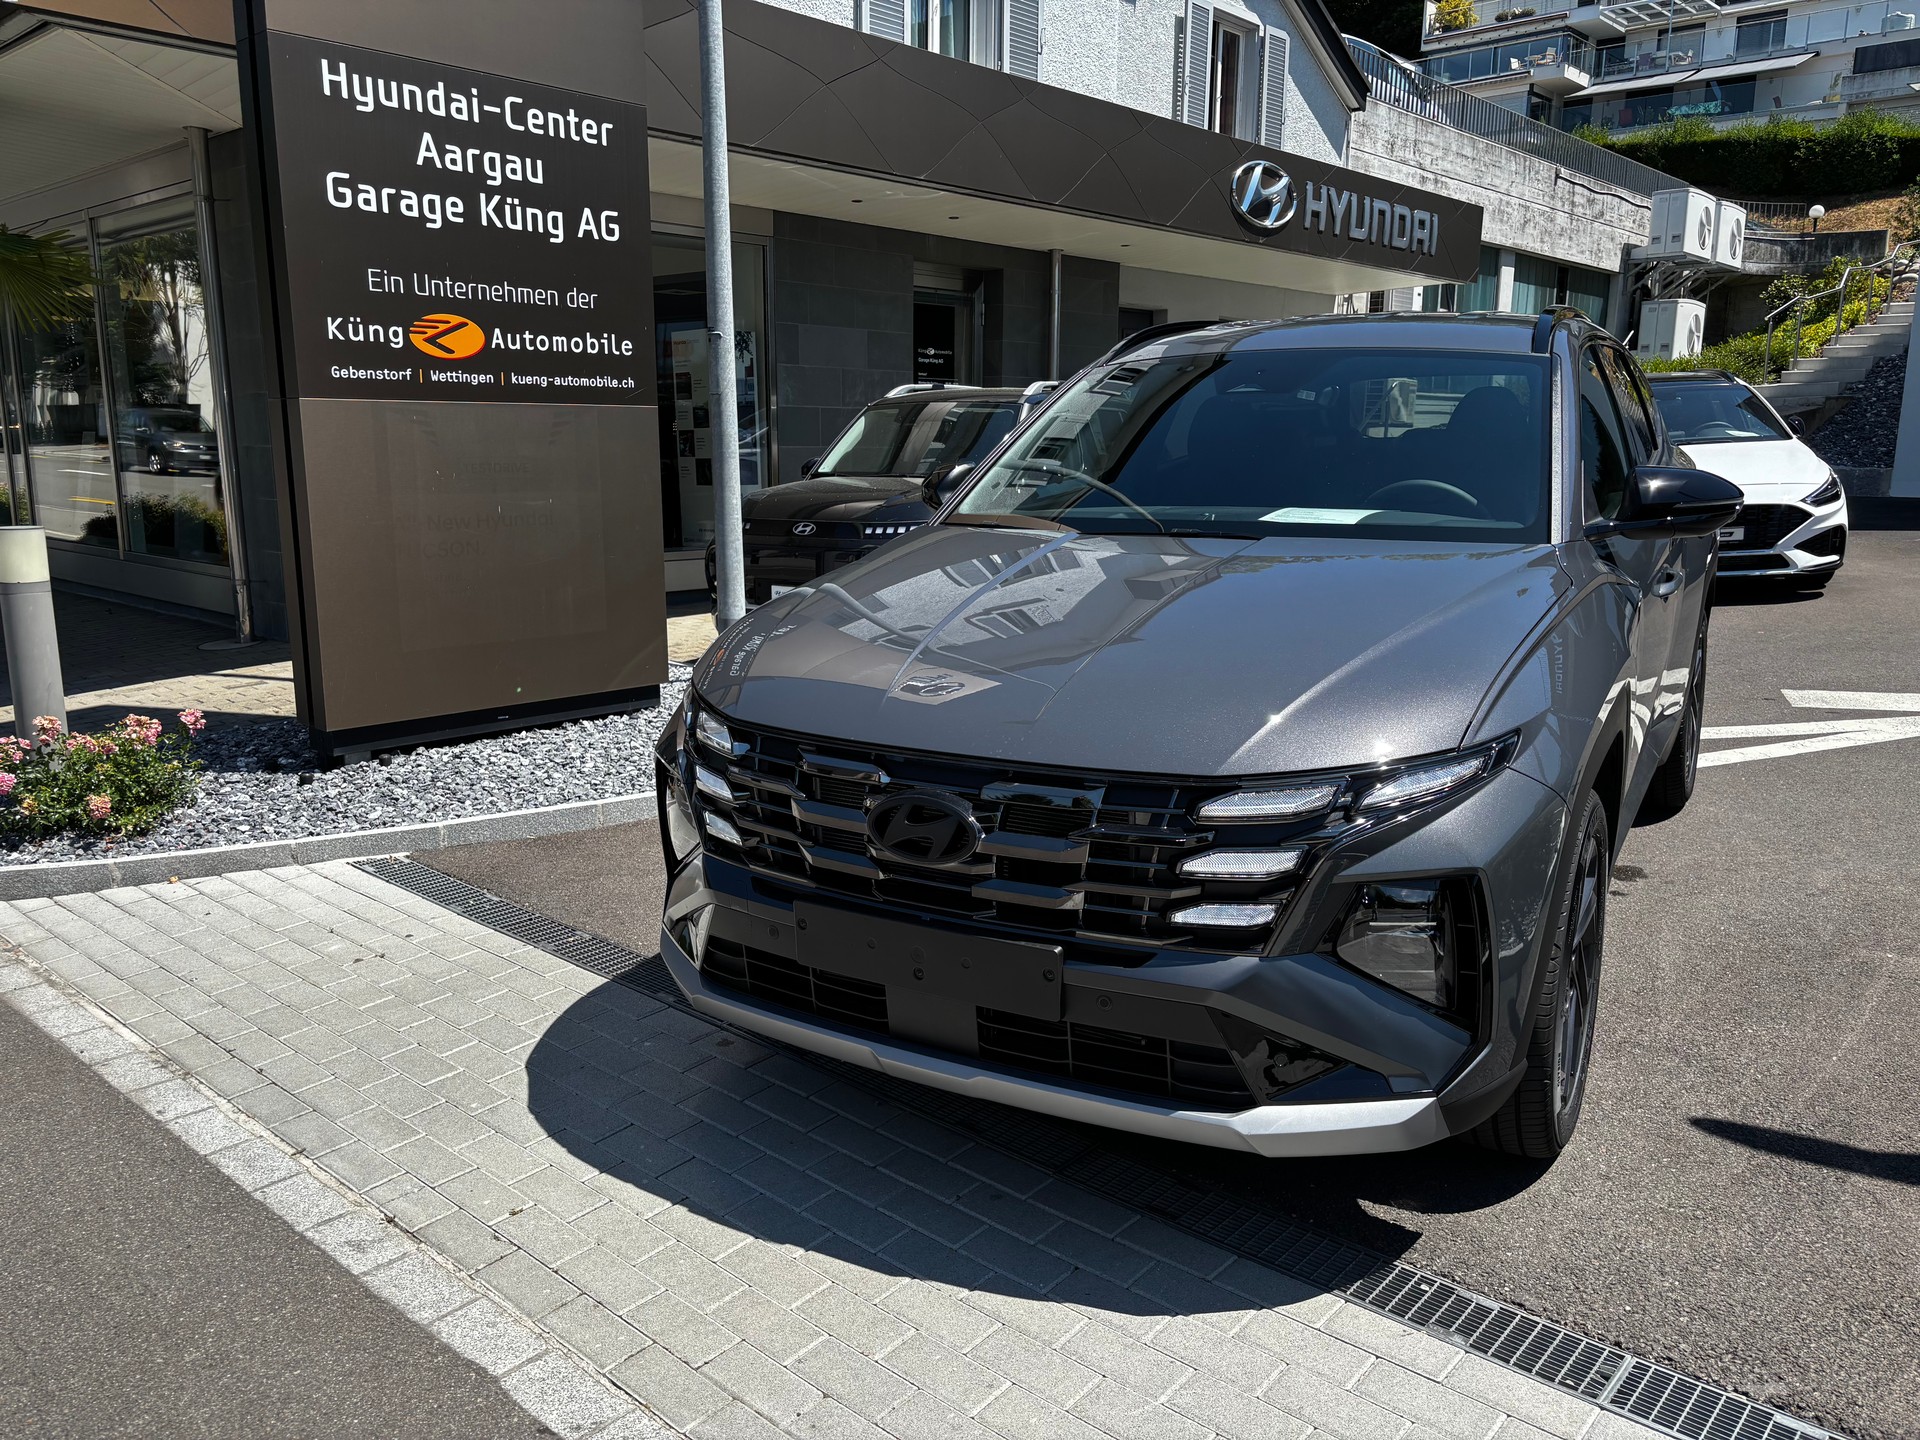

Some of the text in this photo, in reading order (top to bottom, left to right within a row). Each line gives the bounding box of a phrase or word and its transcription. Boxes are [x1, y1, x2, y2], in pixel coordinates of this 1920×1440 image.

[320, 58, 614, 147] Hyundai-Center
[416, 131, 544, 187] Aargau
[325, 171, 620, 244] Garage Küng AG
[1303, 180, 1439, 257] HYUNDAI
[367, 268, 599, 309] Ein Unternehmen der
[326, 316, 634, 356] Küng Automobile
[330, 365, 635, 389] Gebenstorf Wettingen kueng-automobile.ch
